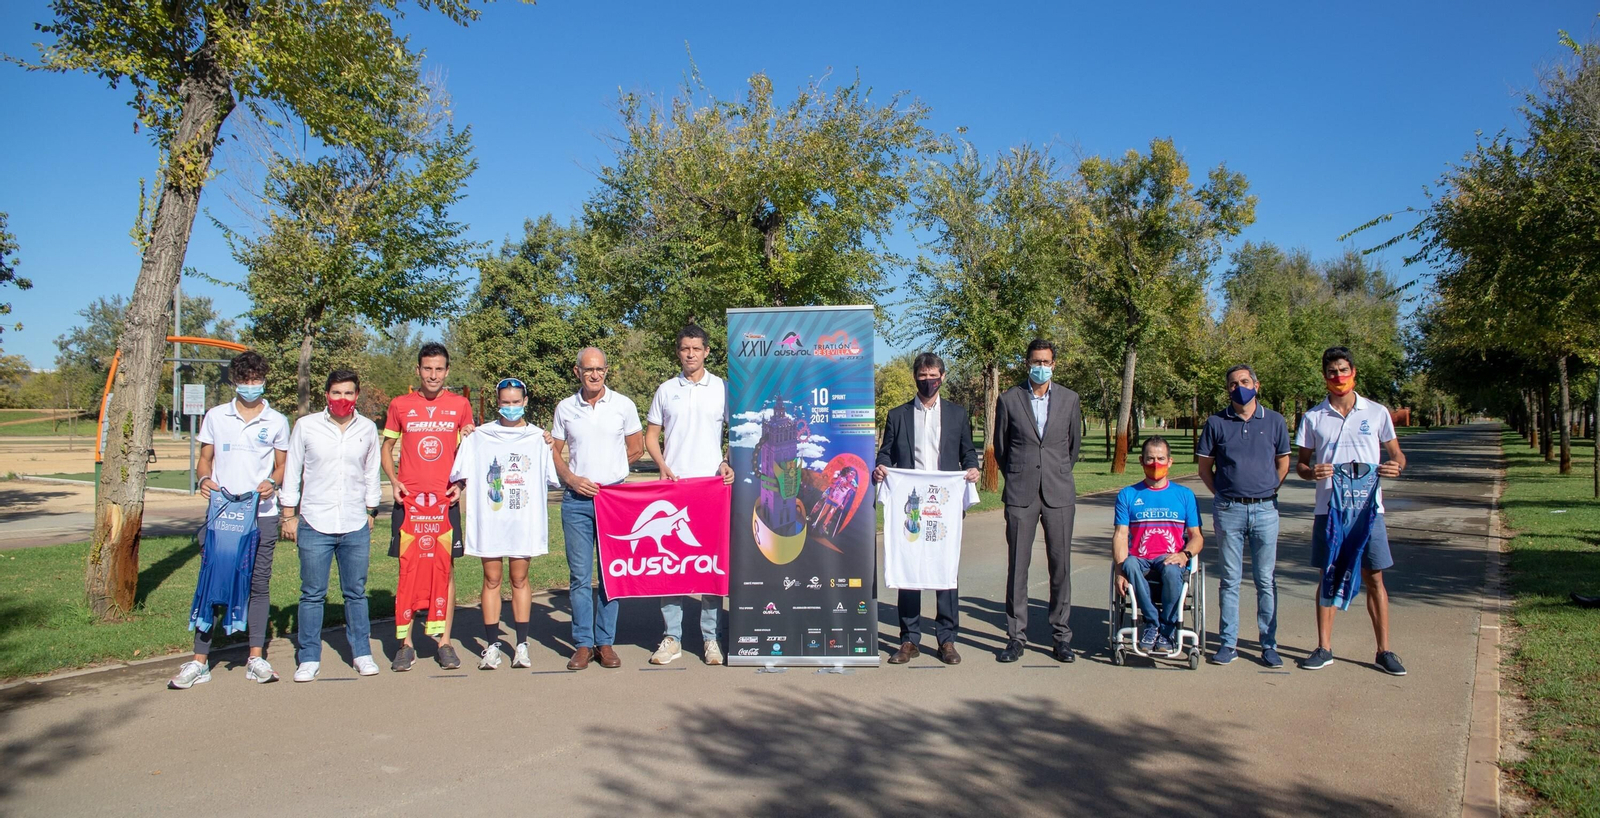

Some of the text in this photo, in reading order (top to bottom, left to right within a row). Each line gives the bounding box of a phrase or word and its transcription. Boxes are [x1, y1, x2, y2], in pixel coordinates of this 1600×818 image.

[738, 340, 773, 357] XXIV
[811, 388, 828, 406] 10
[811, 414, 828, 423] 2021
[1344, 490, 1369, 498] ADS
[218, 512, 244, 520] ADS
[215, 520, 244, 532] M.Barranco
[414, 523, 440, 533] ALI SAAD
[609, 555, 726, 577] austral
